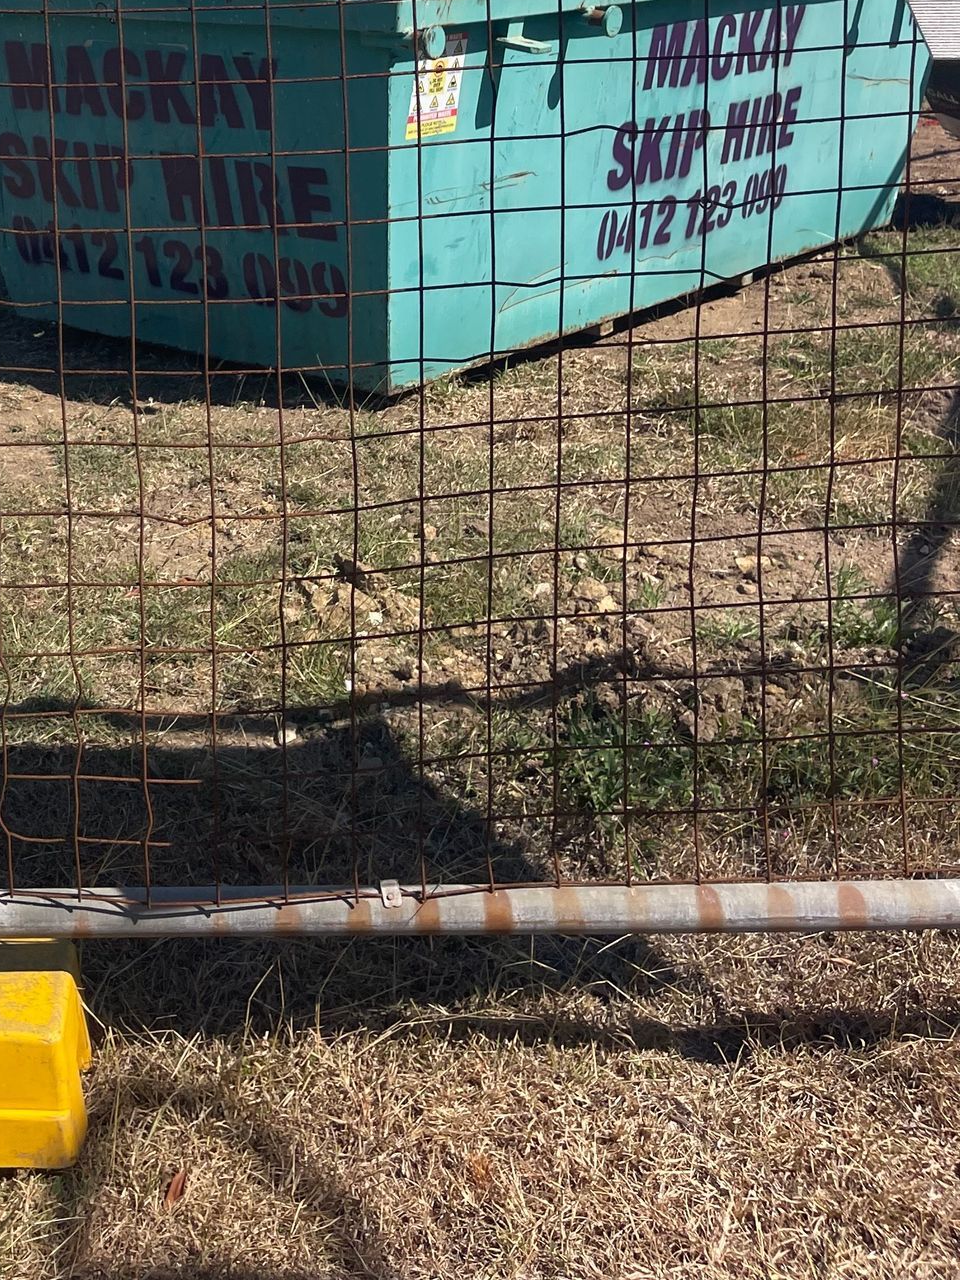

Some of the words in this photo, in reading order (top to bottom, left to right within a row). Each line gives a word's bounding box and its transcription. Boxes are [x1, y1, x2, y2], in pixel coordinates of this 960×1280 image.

[4, 40, 278, 131] MACKAY
[642, 3, 807, 91] MACKAY
[606, 109, 711, 192] SKIP
[720, 86, 802, 165] HIRE
[160, 151, 338, 242] HIRE
[596, 195, 677, 262] 0412
[685, 180, 738, 240] 123
[12, 215, 125, 281] 0412
[135, 235, 230, 299] 123
[243, 251, 348, 318] 099
